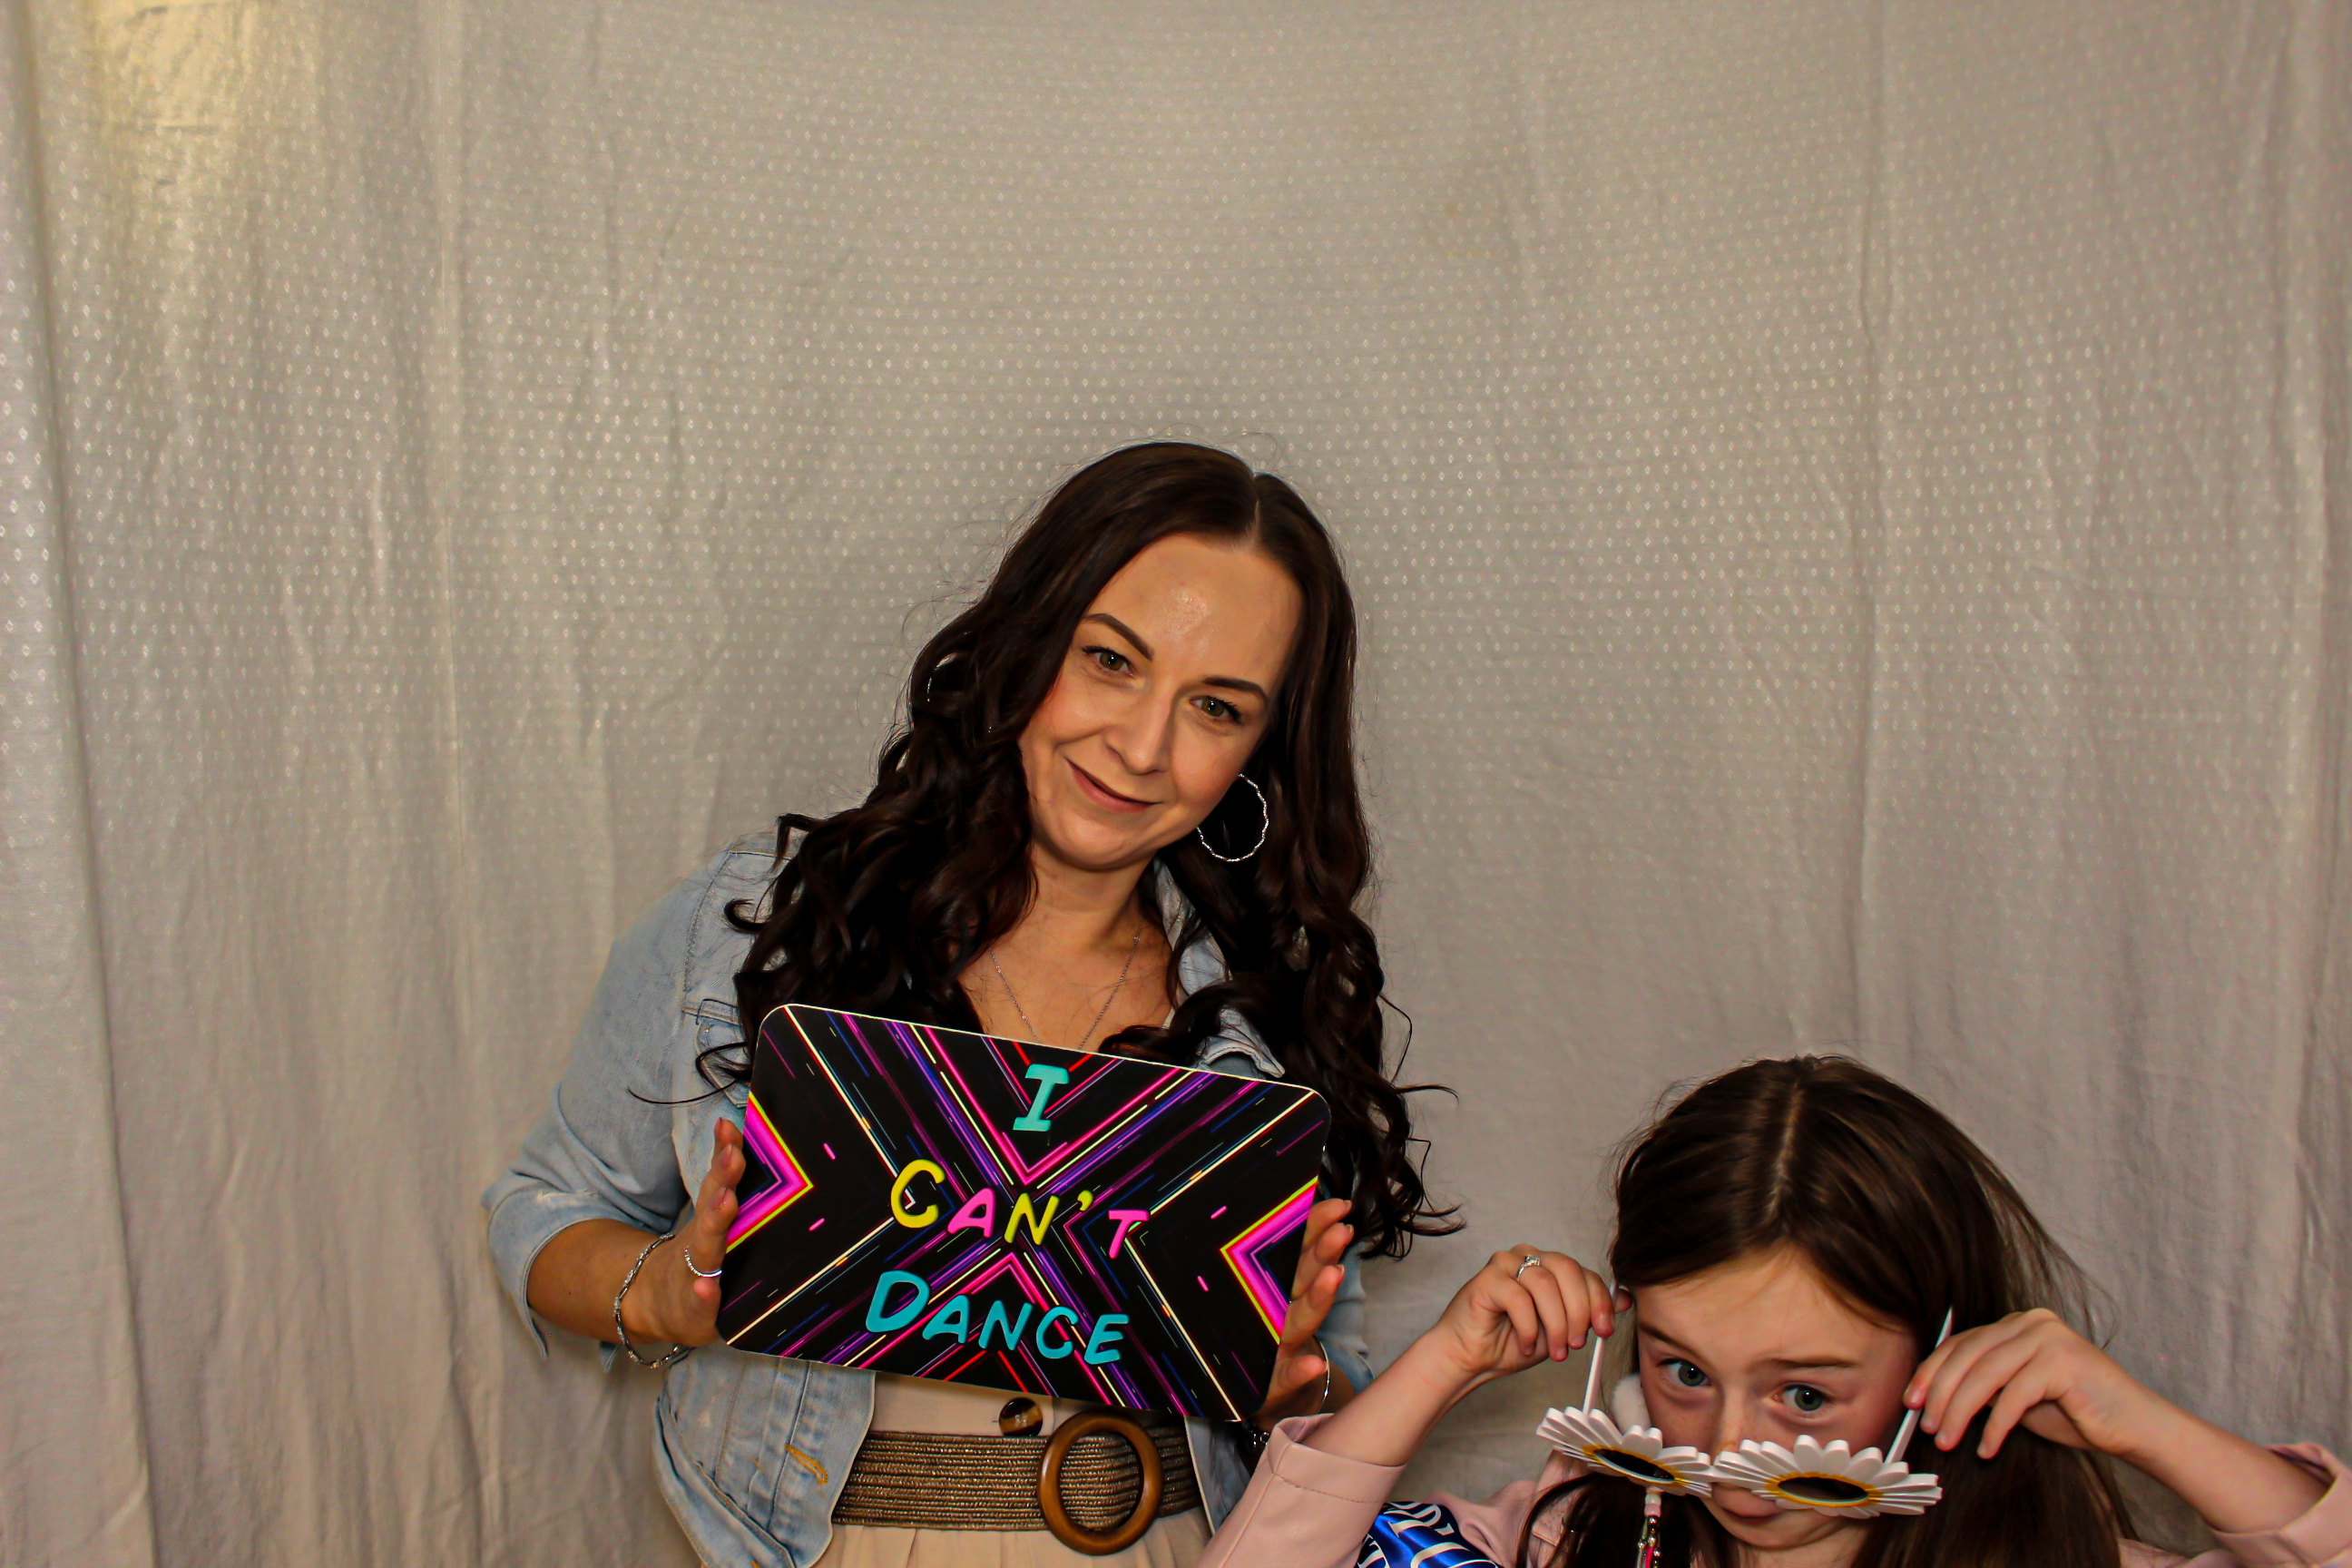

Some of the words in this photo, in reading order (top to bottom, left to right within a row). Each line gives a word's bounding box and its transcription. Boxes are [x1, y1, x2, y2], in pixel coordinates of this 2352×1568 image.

[1014, 1064, 1069, 1132] I
[891, 1160, 1149, 1259] CAN'T
[866, 1271, 1129, 1365] DANCE
